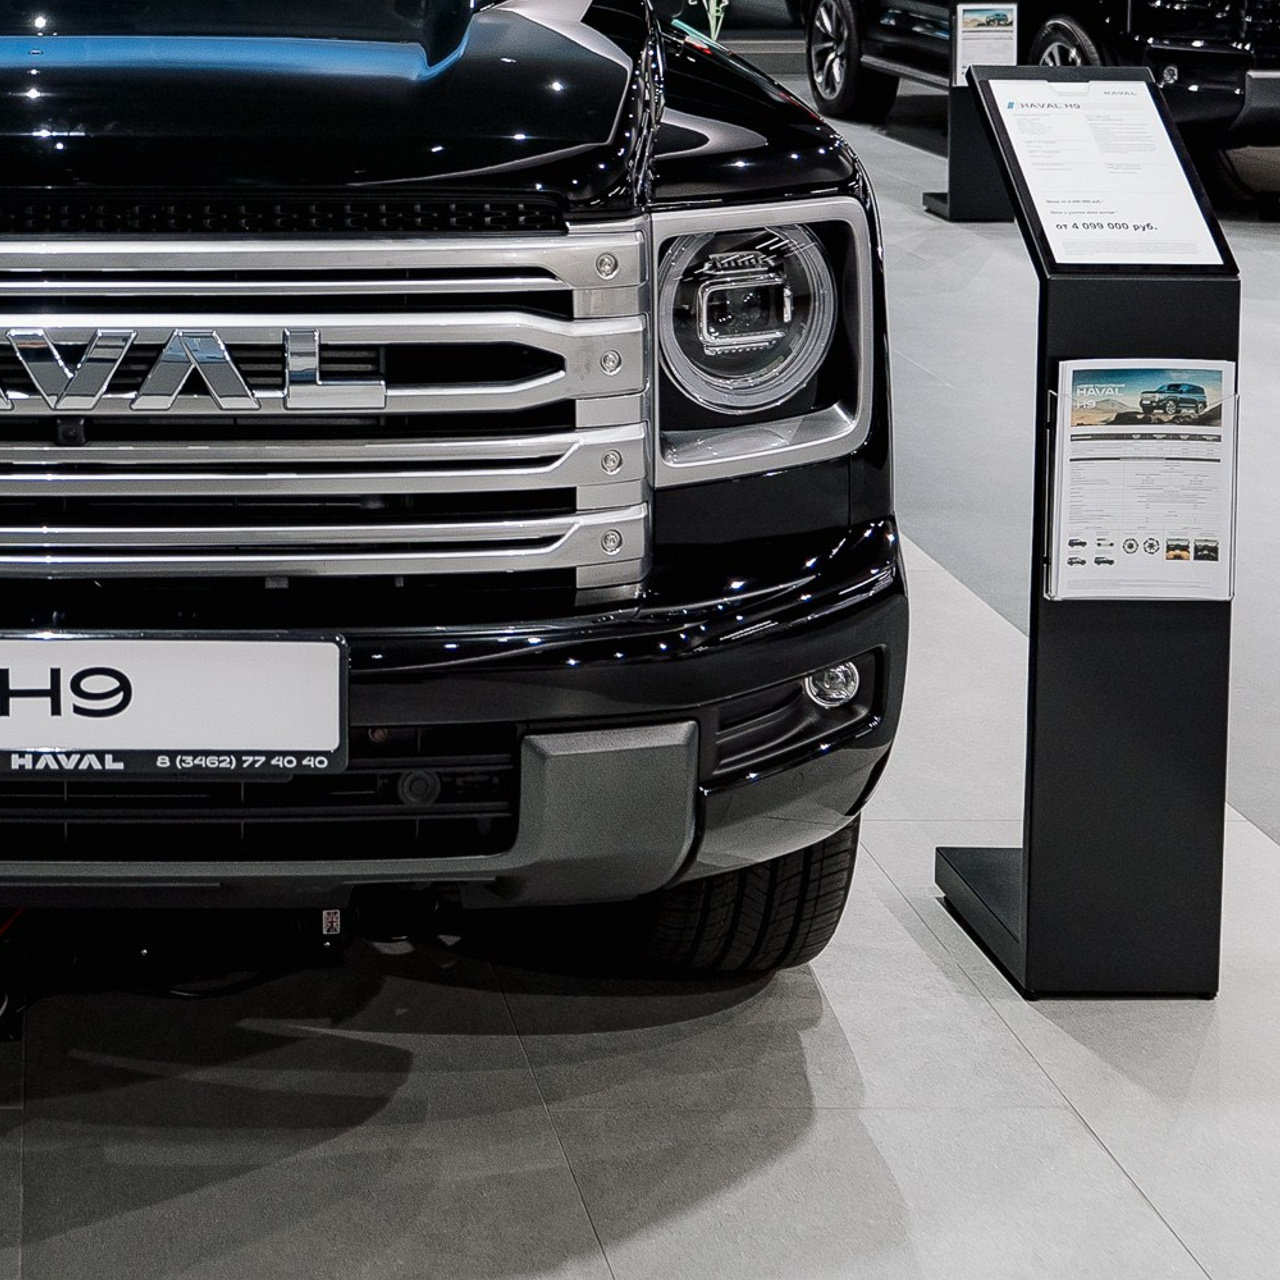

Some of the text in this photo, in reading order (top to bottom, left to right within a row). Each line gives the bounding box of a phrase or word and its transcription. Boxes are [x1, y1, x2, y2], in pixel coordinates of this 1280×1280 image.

[1072, 222, 1079, 230] 4
[1082, 222, 1104, 230] 099
[1107, 222, 1129, 230] 000
[1133, 223, 1158, 231] руб.
[1076, 387, 1124, 397] HAVAL
[1076, 400, 1096, 409] H9
[11, 753, 124, 770] HAVAL
[156, 755, 328, 769] 8 (3462) 77 40 40
